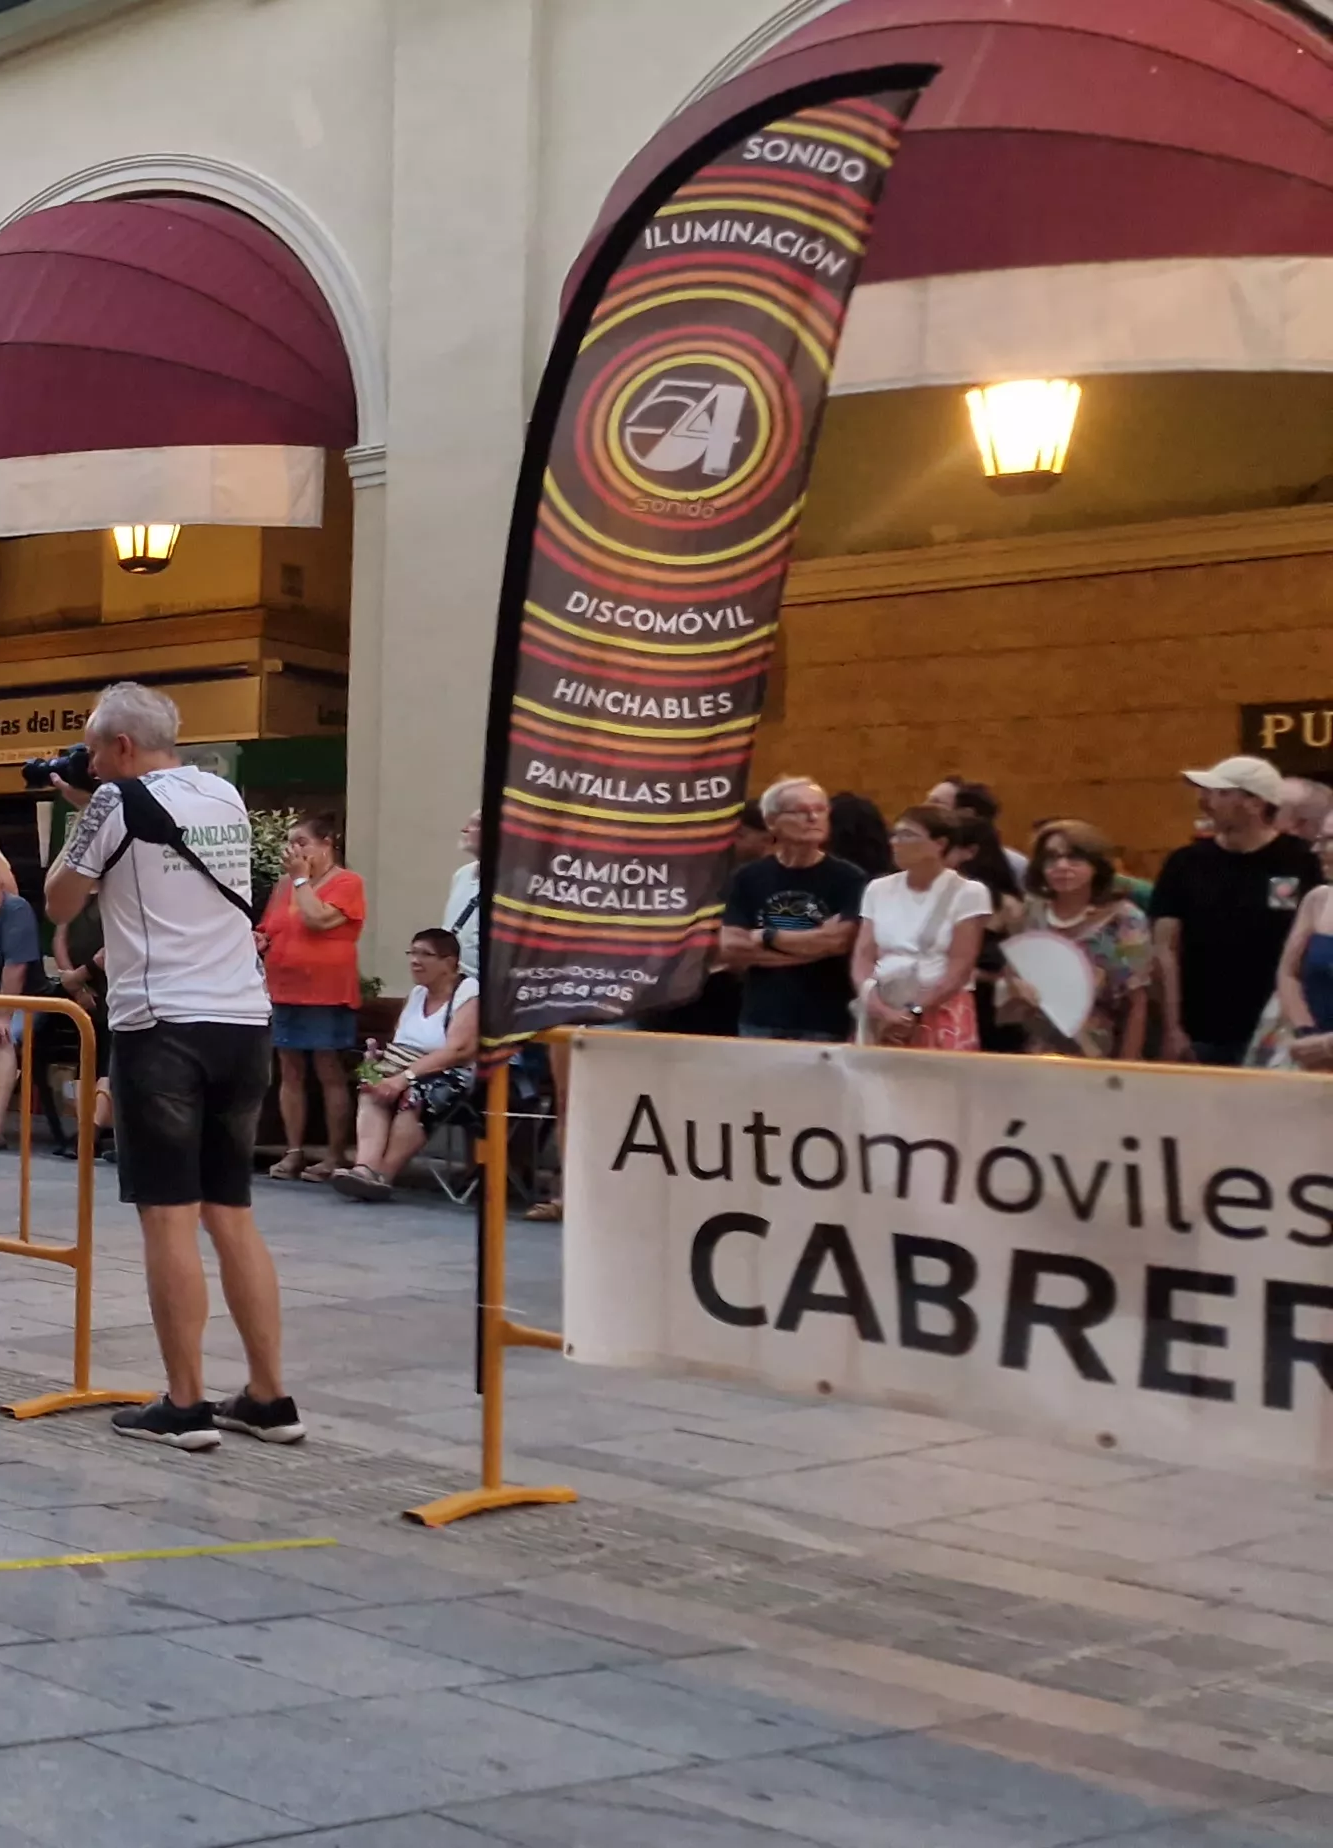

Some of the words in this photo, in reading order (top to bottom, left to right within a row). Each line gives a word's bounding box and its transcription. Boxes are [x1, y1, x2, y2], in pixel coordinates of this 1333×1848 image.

[742, 135, 866, 182] SONIDO
[644, 218, 847, 277] ILUMINACIÓN
[633, 494, 716, 520] sonido
[564, 590, 755, 635] DISCOMÓVIL
[26, 709, 56, 733] del
[552, 677, 735, 720] HINCHABLES
[525, 759, 672, 804] PANTALLAS
[679, 775, 732, 803] LED
[526, 873, 689, 910] PASACALLES
[551, 853, 669, 885] CAMIÓN
[610, 1093, 1333, 1249] Automóviles
[688, 1211, 1333, 1411] CABRER
